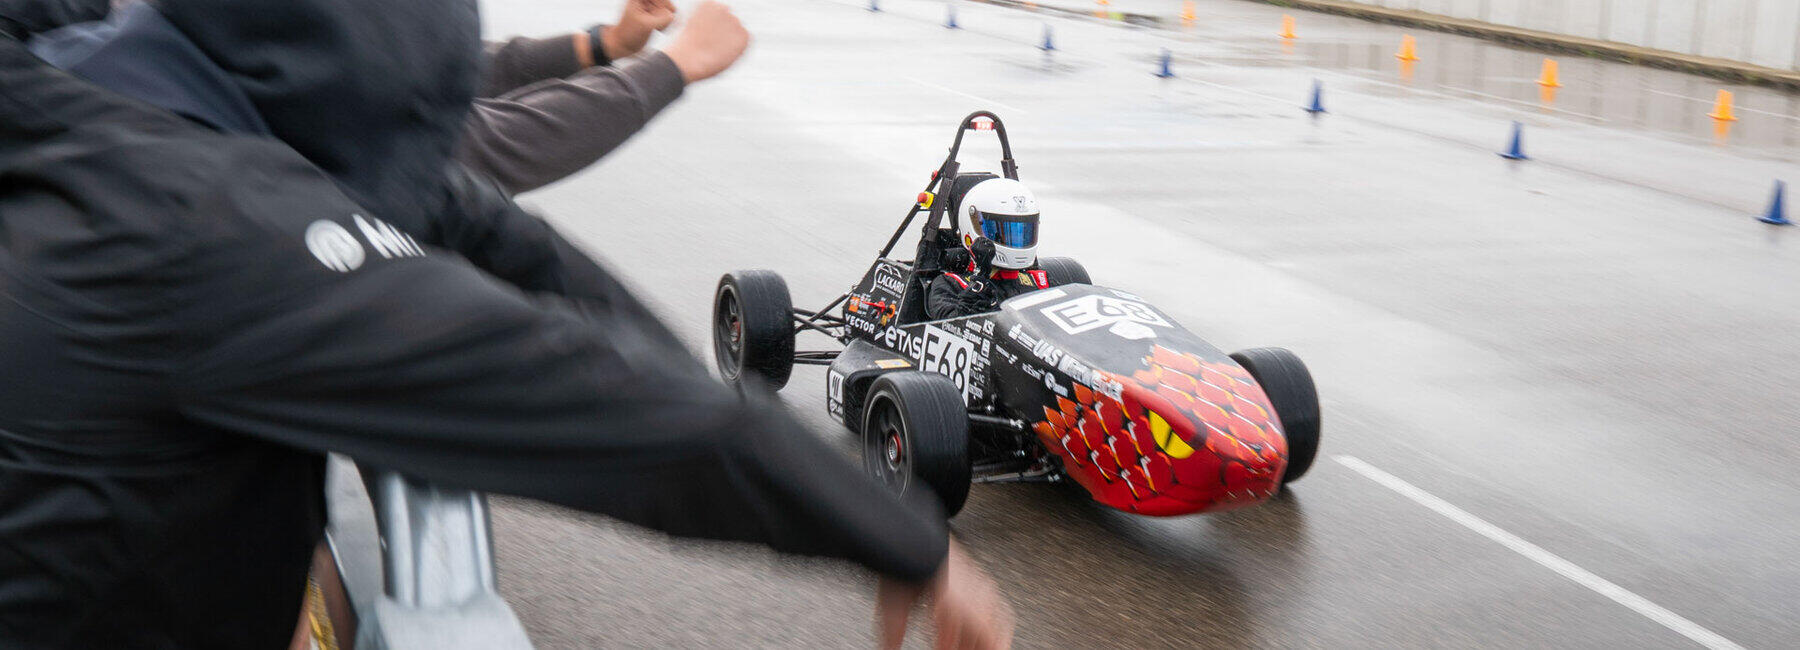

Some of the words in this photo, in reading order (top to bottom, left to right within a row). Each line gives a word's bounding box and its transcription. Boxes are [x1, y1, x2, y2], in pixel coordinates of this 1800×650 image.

[845, 313, 876, 334] VECTOR
[1052, 298, 1158, 329] E68
[1033, 340, 1064, 368] UAS
